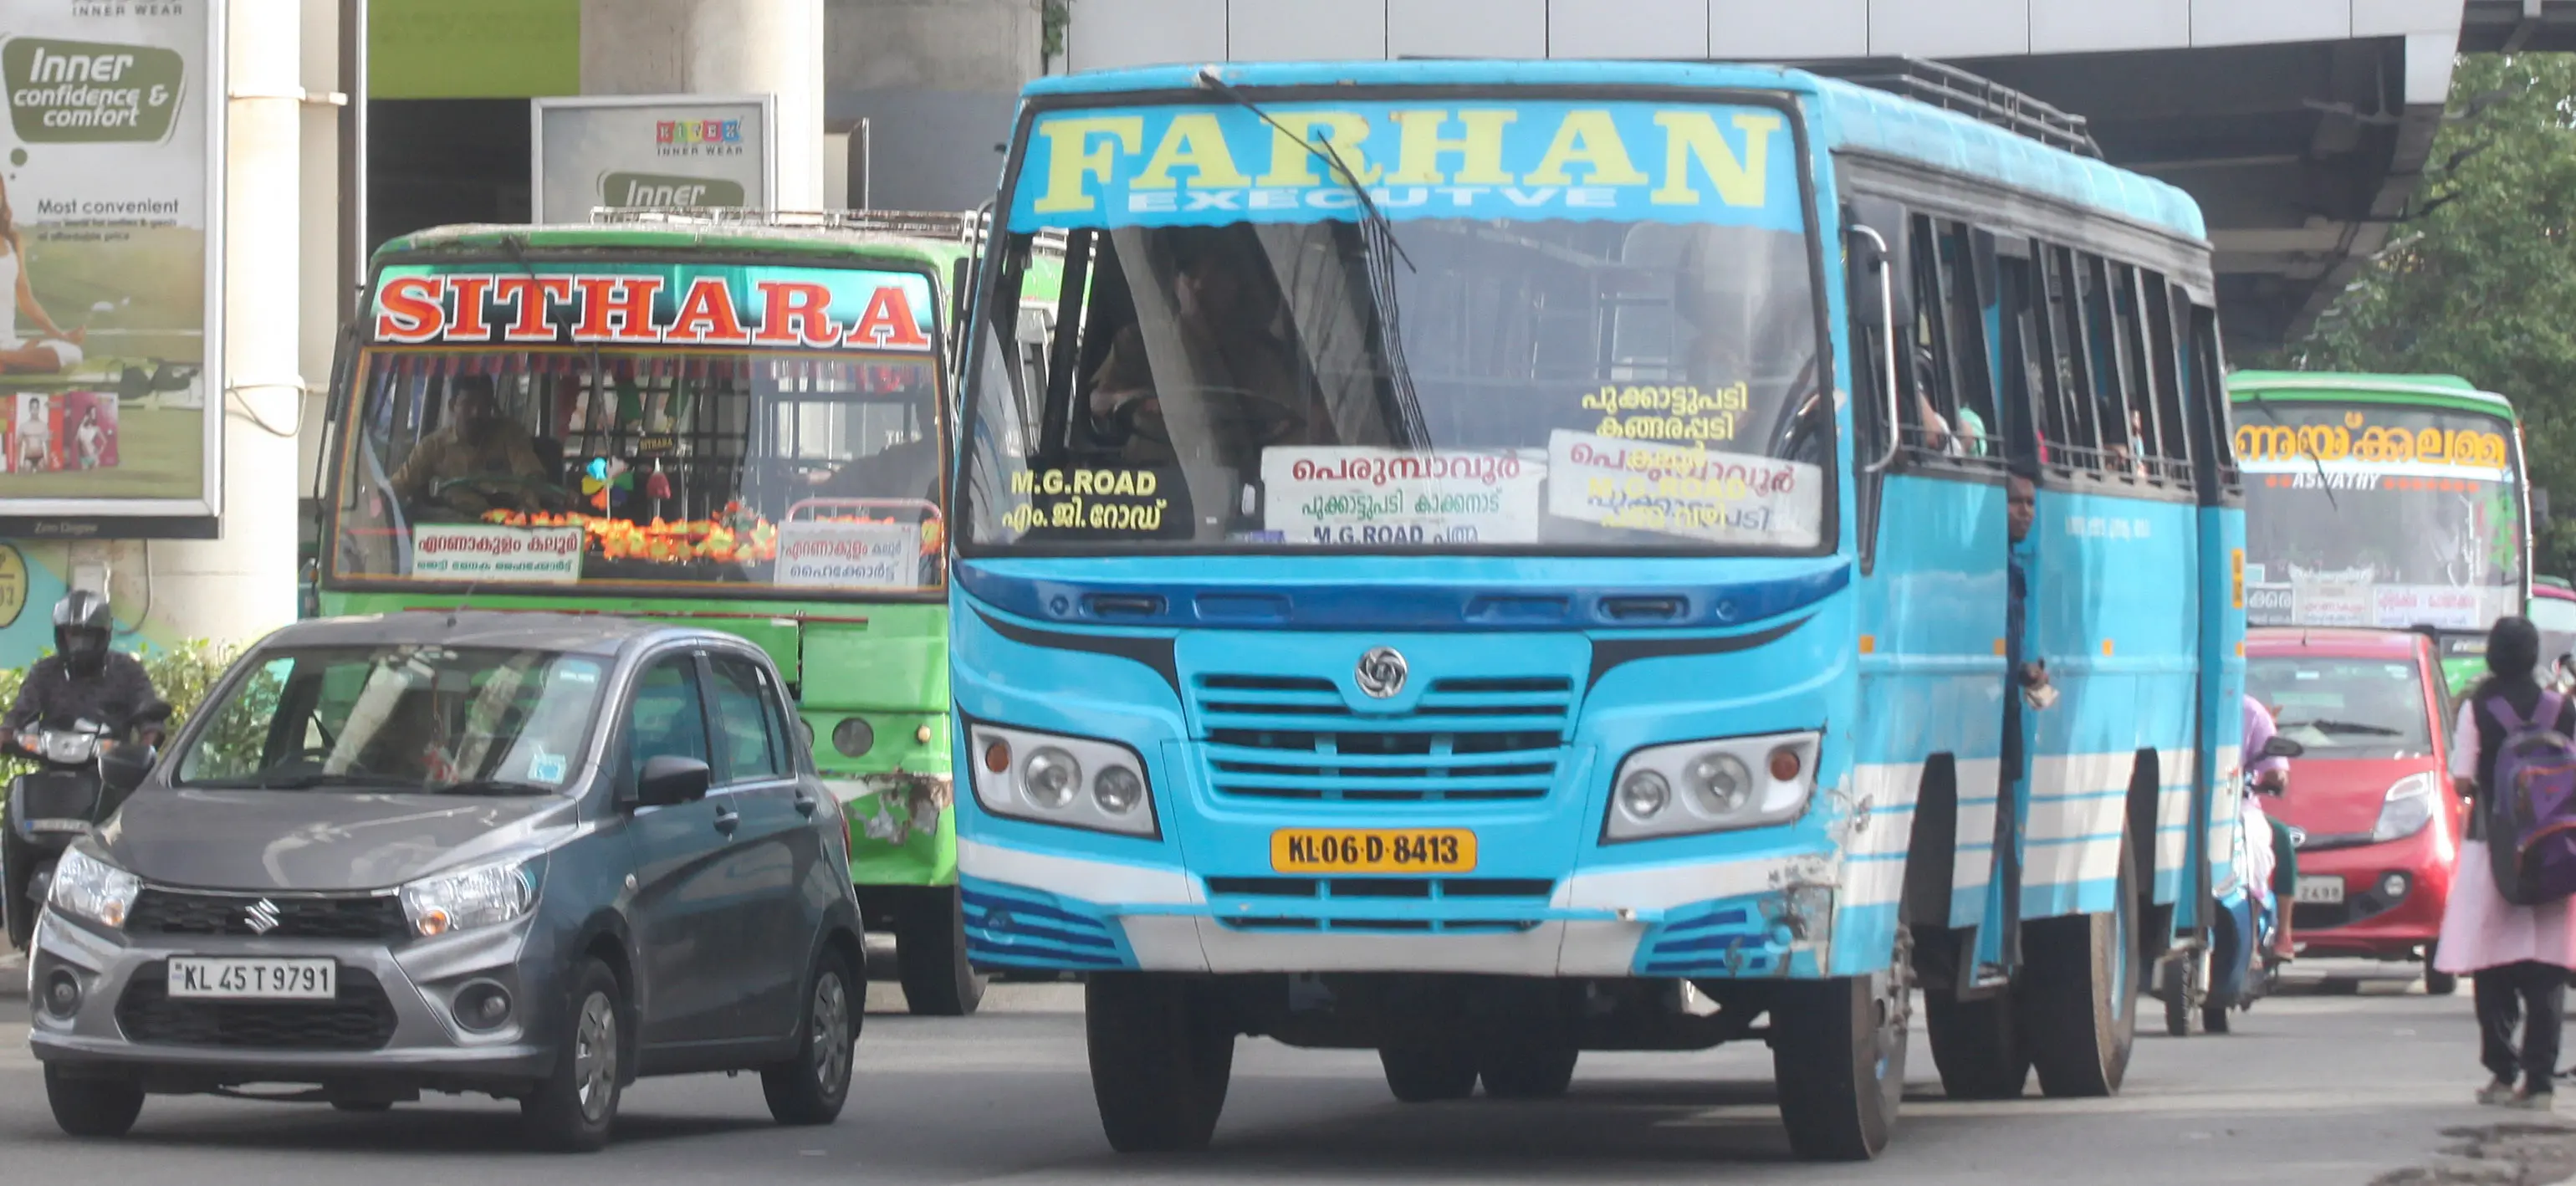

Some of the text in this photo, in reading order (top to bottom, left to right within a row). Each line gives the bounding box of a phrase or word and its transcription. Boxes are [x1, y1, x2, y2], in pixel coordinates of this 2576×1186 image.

[135, 4, 182, 16] WEAR
[29, 47, 134, 83] Inner
[13, 84, 169, 108] confidence &
[43, 106, 140, 128] comfort
[705, 146, 743, 156] WEAR
[1035, 109, 1781, 210] FARHAN
[625, 178, 706, 207] Inner
[1127, 187, 1618, 212] EXECUTVE
[38, 197, 179, 215] Most convenient
[375, 273, 932, 351] SITHARA
[1291, 449, 1522, 487] പെരുമ്പാവൂർ
[1011, 469, 1157, 495] M.G.ROAD
[418, 535, 523, 555] എറണാകുളം
[1313, 525, 1423, 544] M.G.ROAD
[185, 965, 329, 993] KL 45 T 9791
